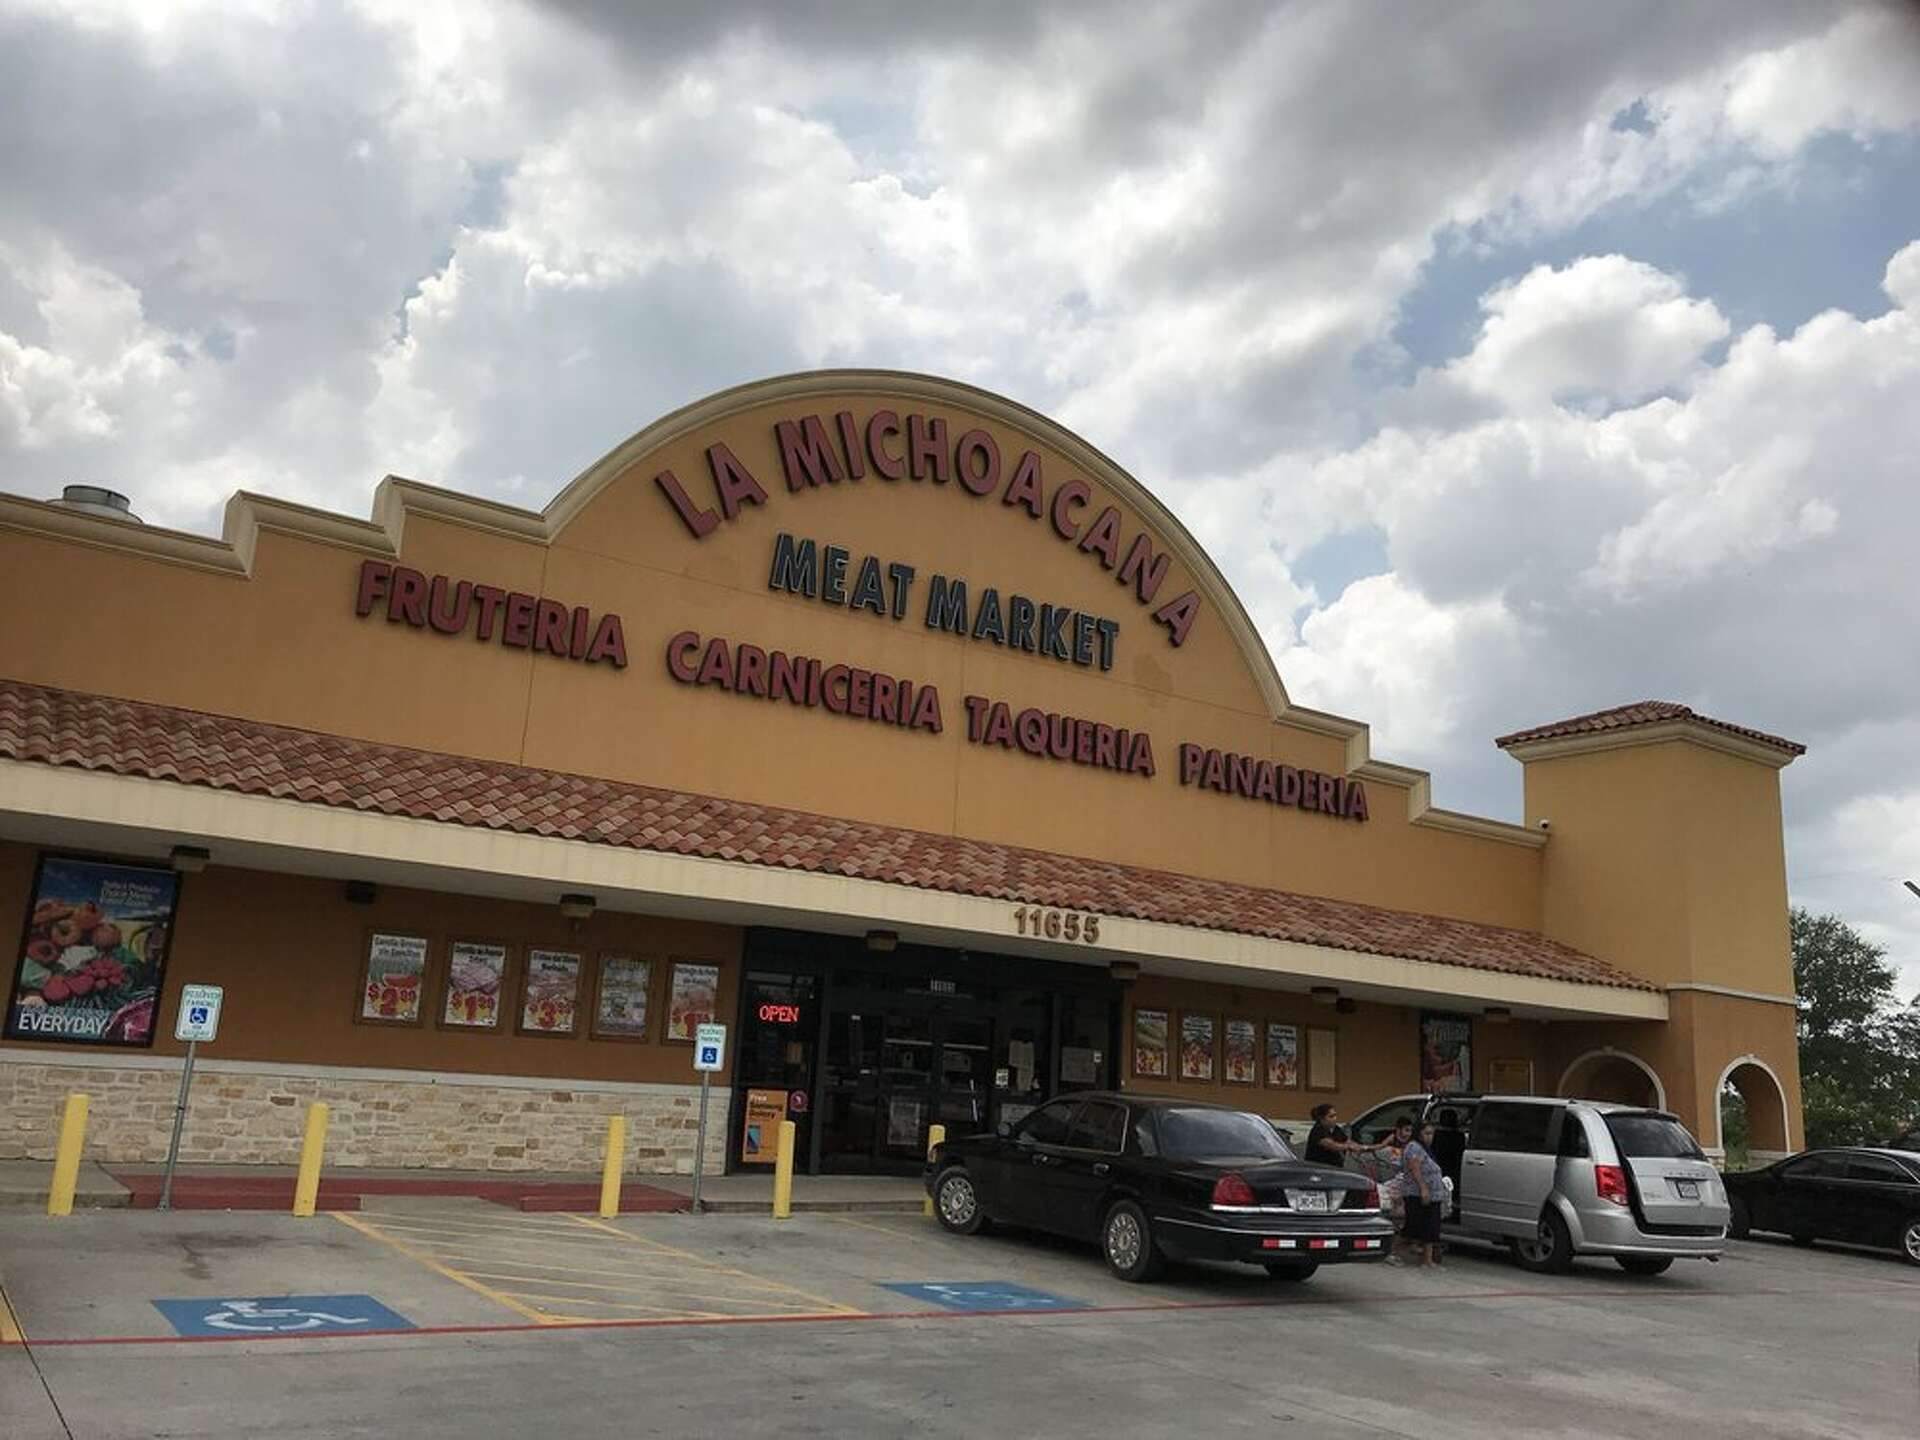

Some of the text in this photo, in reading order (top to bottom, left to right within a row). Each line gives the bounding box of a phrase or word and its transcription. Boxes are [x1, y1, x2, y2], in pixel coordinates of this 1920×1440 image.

[654, 411, 1201, 647] LA MICHOACANA
[769, 533, 1119, 671] MEAT MARKET
[356, 559, 1369, 821] FRUTERIA CARNICERIA TAQUERIA PANADERIA
[1014, 906, 1100, 945] 11655
[18, 1013, 106, 1035] EVERYDAY
[759, 1004, 799, 1022] OPEN
